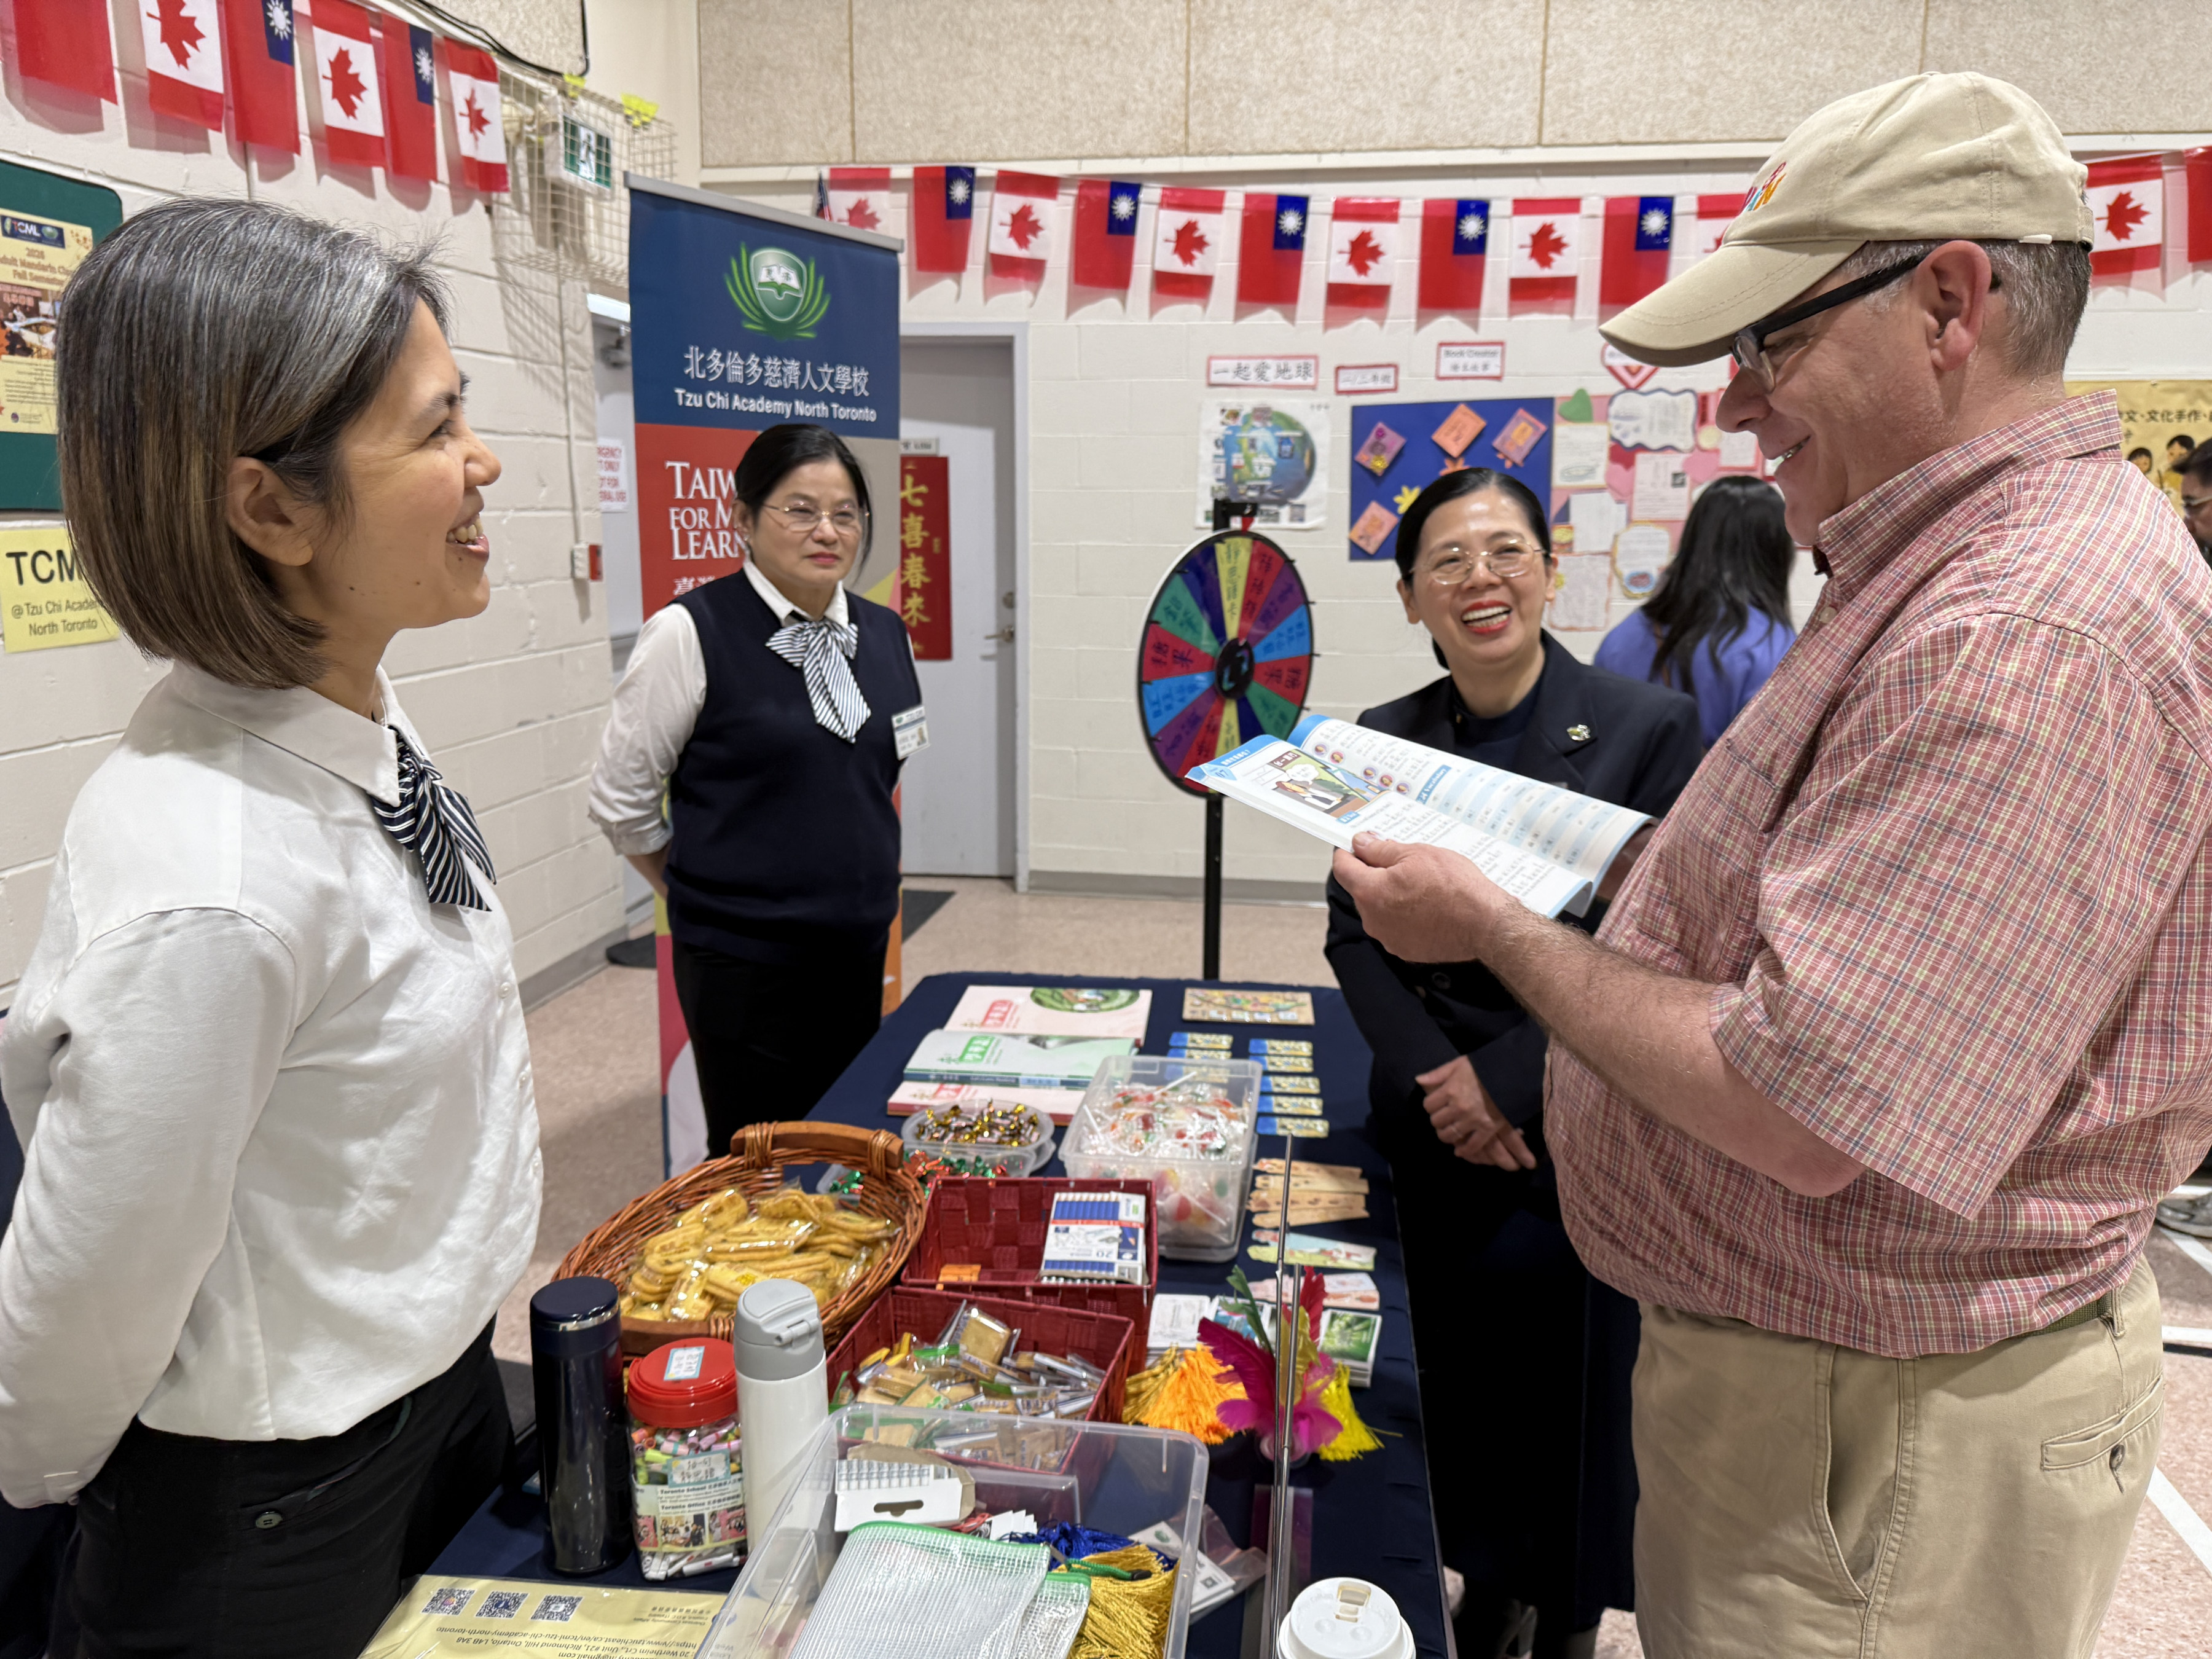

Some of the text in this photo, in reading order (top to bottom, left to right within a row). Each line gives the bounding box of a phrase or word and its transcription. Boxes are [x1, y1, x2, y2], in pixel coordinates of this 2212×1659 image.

[12, 220, 41, 237] TCML
[684, 344, 870, 397] 北多倫多慈濟人文學校
[674, 386, 877, 423] Tzu Chi Academy North Toronto
[665, 460, 738, 500] TAIW
[669, 506, 712, 530] FOR
[11, 605, 23, 619] @
[24, 602, 42, 616] Tzu
[45, 600, 61, 614] Chi
[29, 618, 98, 636] North Toronto
[640, 1648, 679, 1657] Wertheim
